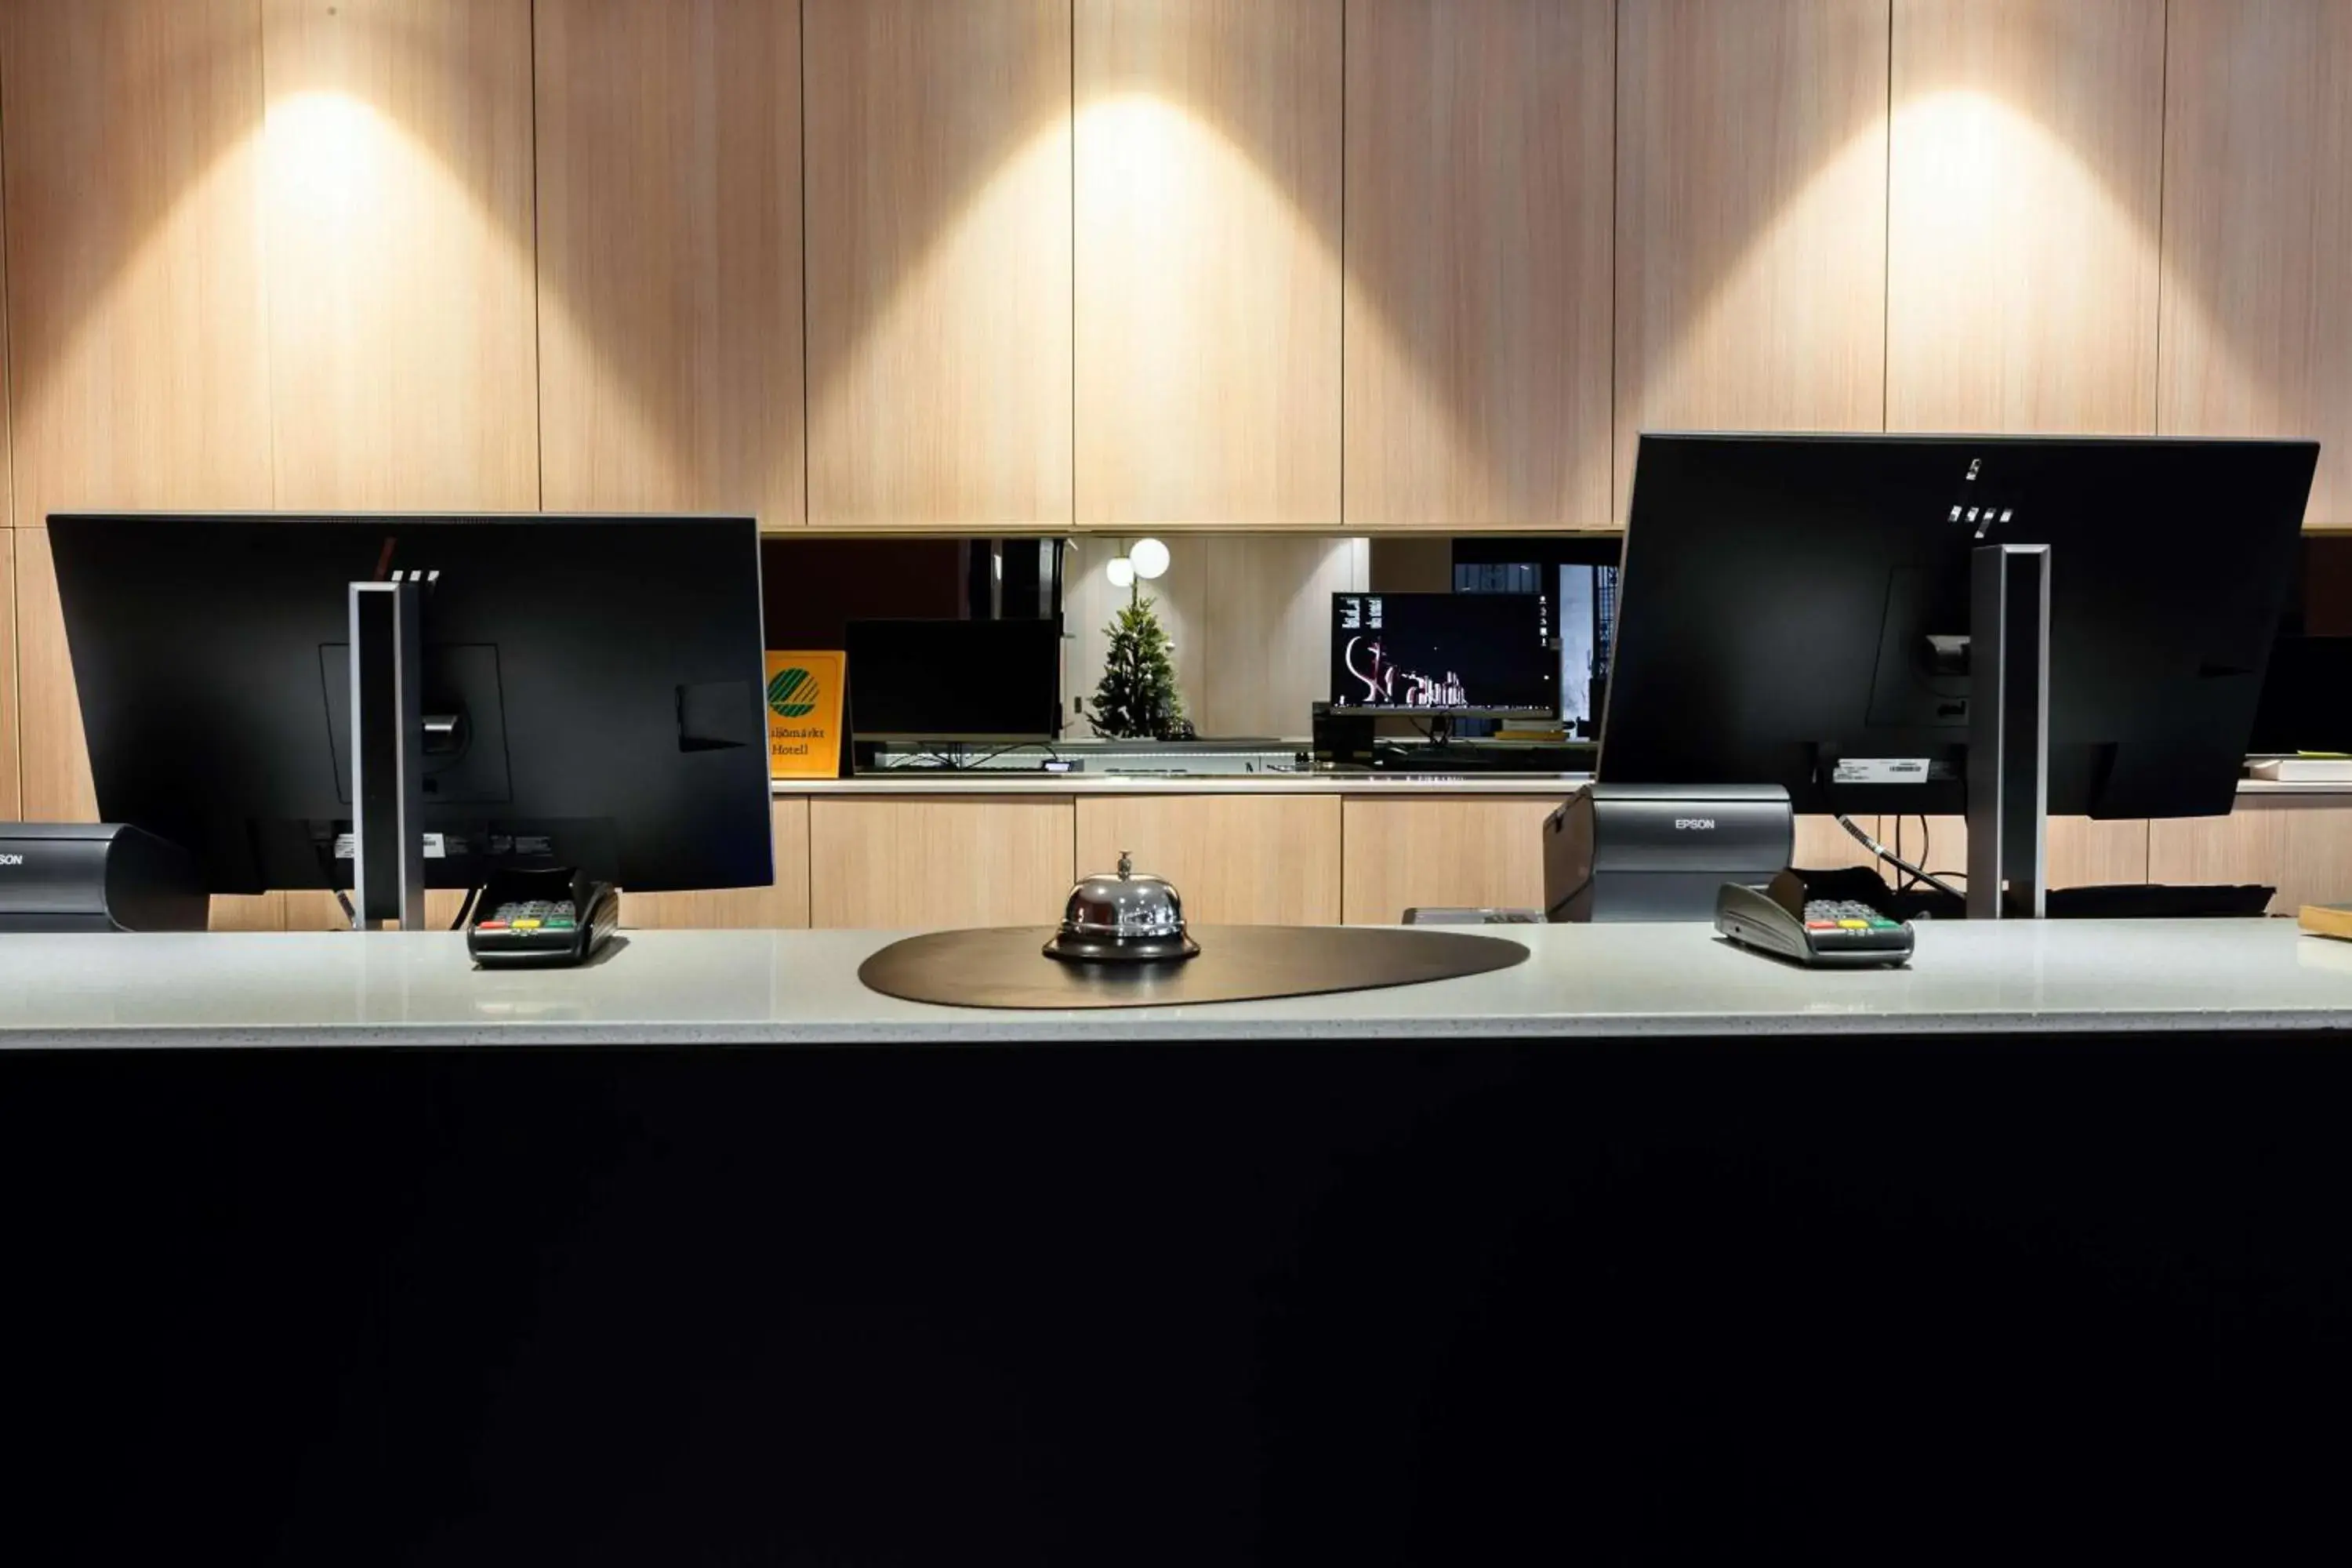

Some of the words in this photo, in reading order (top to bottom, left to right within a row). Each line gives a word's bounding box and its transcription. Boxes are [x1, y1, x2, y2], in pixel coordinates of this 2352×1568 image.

[771, 743, 808, 755] Hotell
[1675, 819, 1715, 829] EPSON
[0, 854, 23, 865] SON
